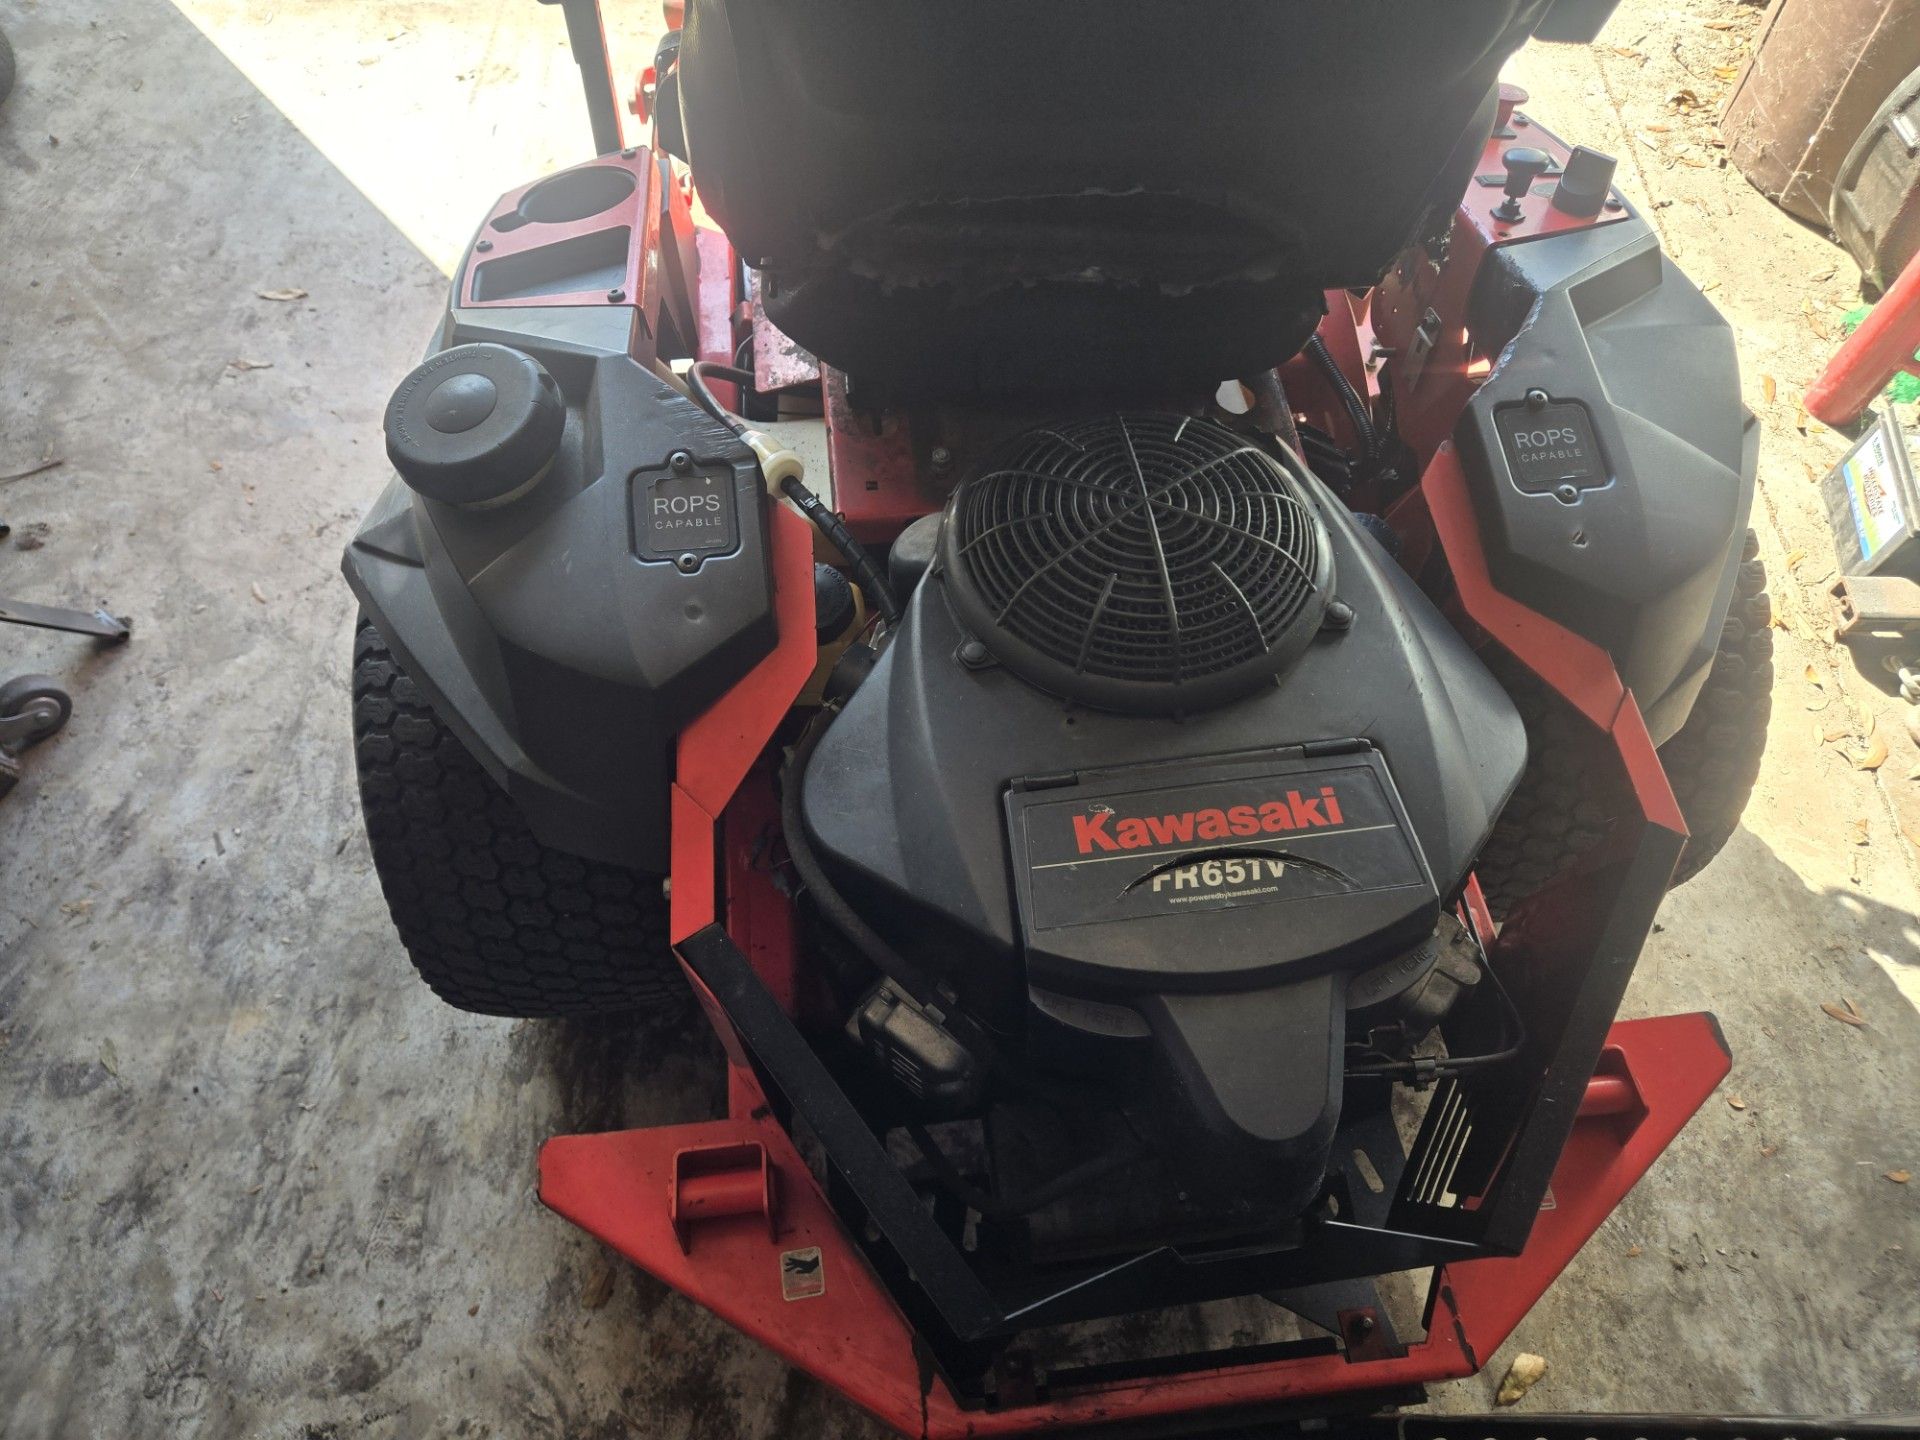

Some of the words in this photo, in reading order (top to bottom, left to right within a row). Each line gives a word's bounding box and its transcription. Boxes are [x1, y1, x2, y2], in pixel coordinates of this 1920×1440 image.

[1513, 428, 1577, 449] ROPS
[1521, 448, 1583, 463] CAPABLE
[654, 494, 720, 515] ROPS
[655, 517, 722, 530] CAPABLE
[1073, 787, 1344, 854] Kawasaki
[1168, 886, 1279, 904] www.poweredbykawasaki.com
